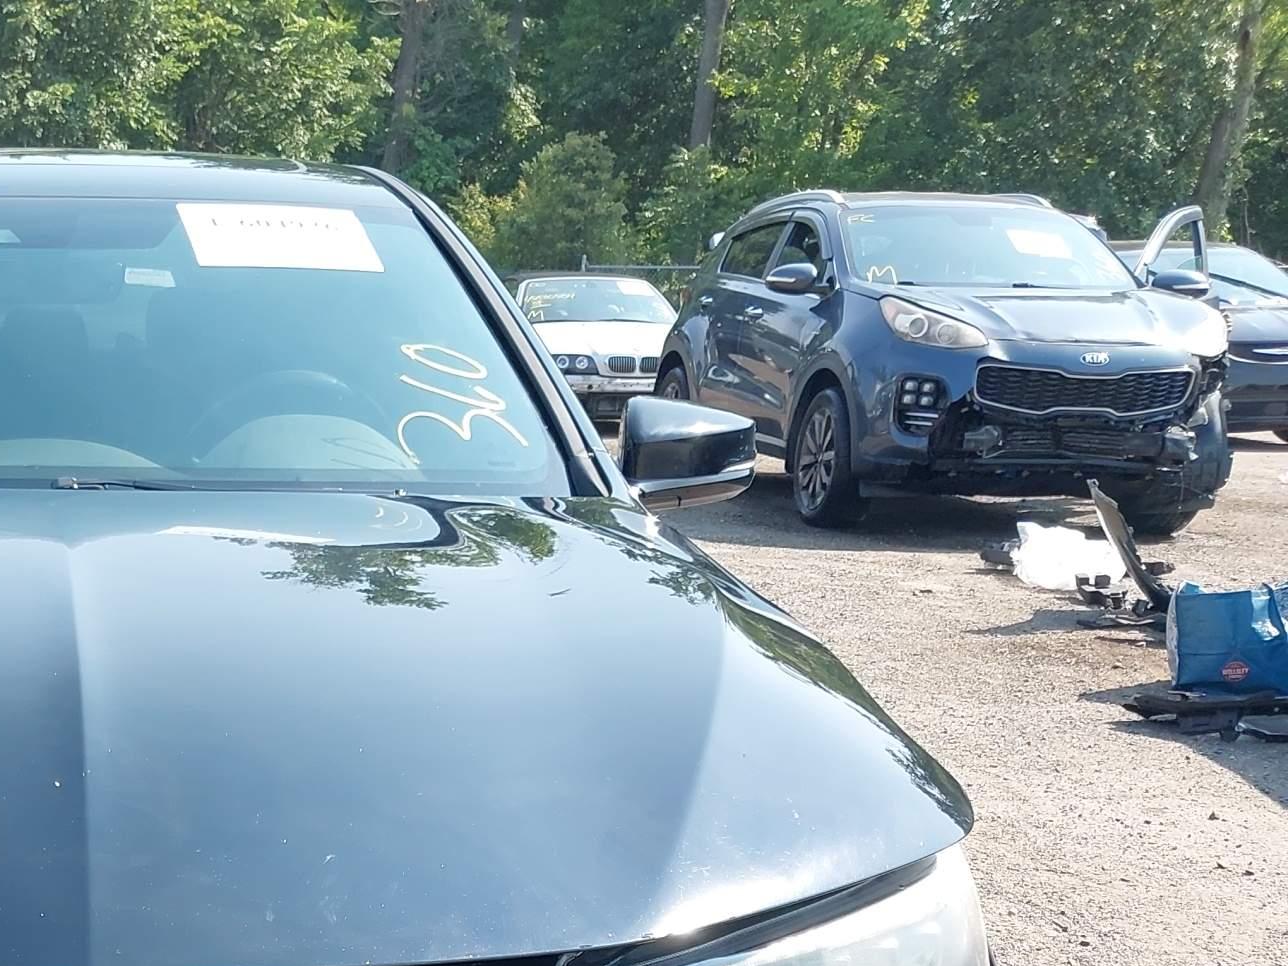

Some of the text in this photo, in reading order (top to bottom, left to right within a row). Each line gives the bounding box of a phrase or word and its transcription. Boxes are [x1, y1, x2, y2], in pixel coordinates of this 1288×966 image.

[866, 265, 898, 287] M
[527, 310, 545, 321] M
[1085, 353, 1108, 363] KIA
